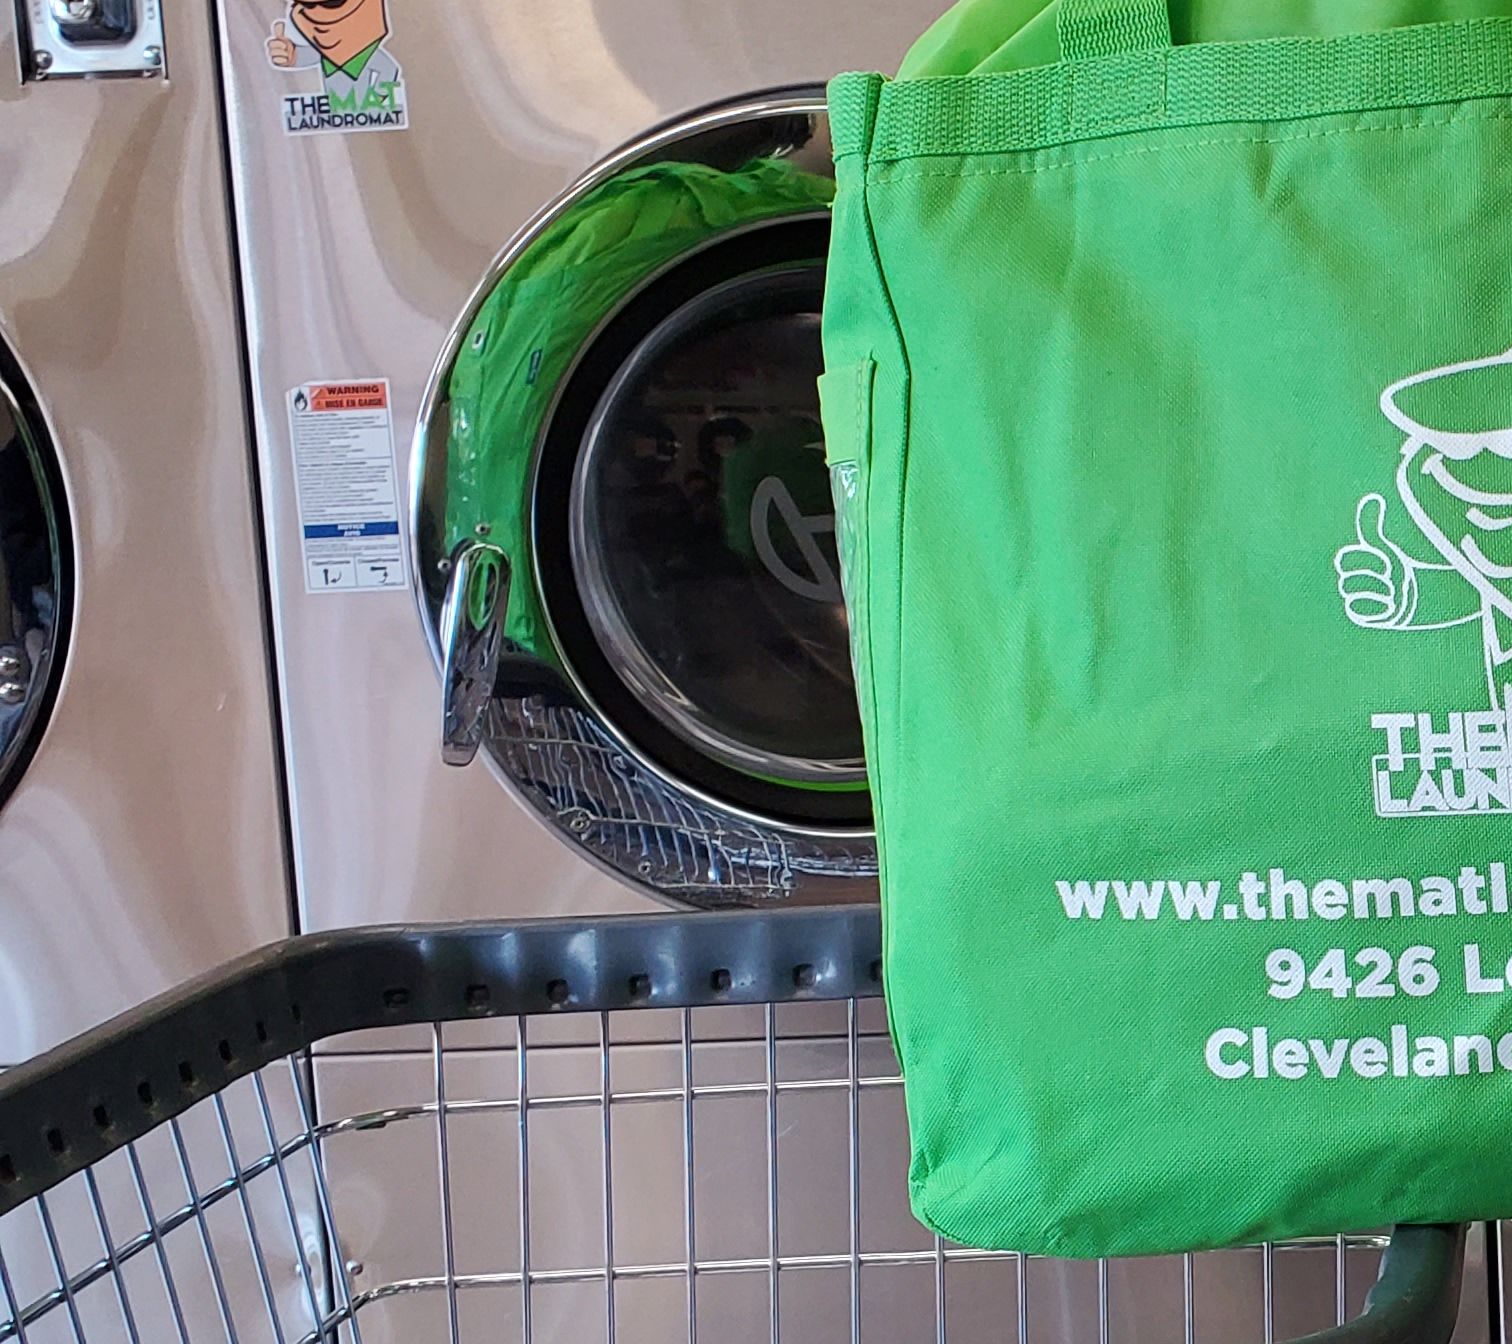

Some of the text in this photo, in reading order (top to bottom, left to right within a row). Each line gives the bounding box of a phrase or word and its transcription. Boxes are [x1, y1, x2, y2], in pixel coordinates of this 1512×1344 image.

[284, 95, 331, 116] THE
[287, 110, 402, 131] LAUNDROMAT
[326, 384, 379, 395] WARNING
[1371, 711, 1508, 771] THE
[1264, 945, 1441, 1000] 9426
